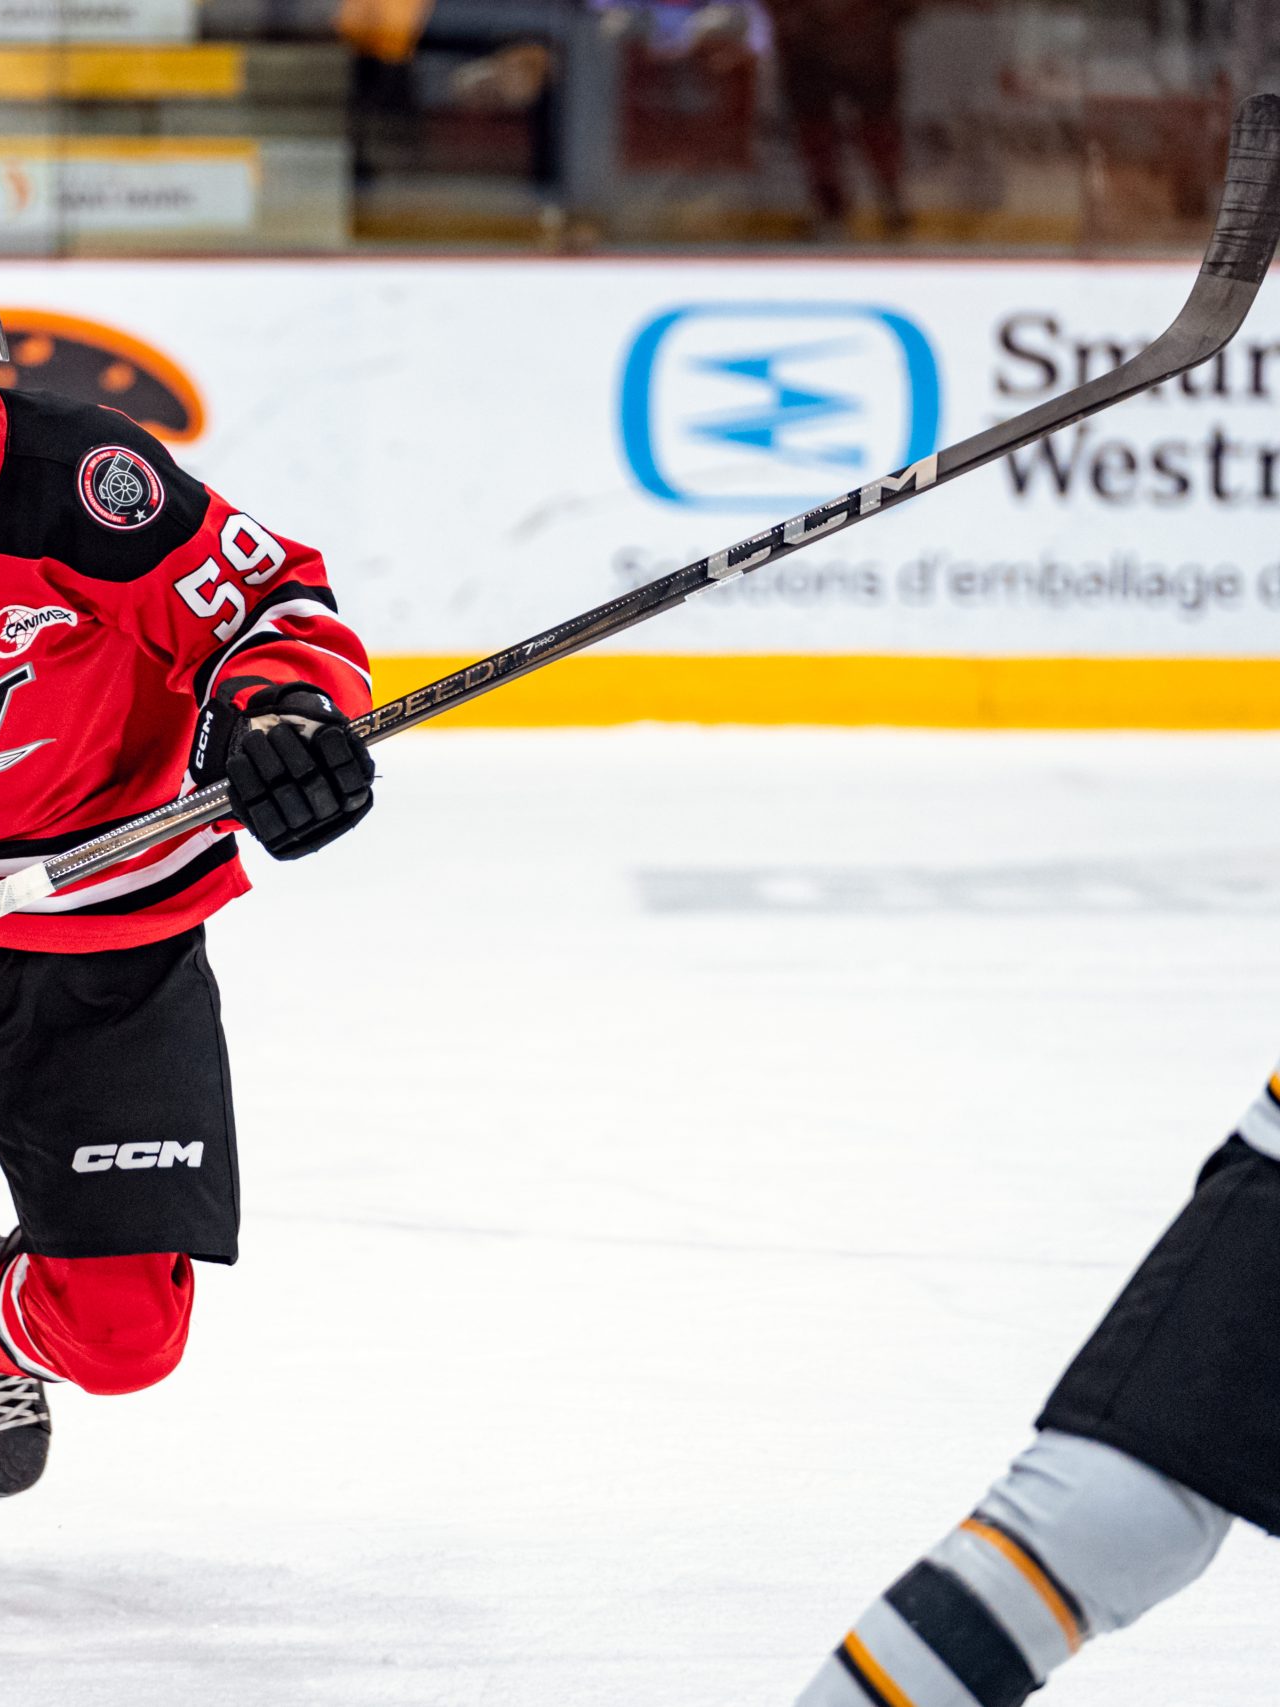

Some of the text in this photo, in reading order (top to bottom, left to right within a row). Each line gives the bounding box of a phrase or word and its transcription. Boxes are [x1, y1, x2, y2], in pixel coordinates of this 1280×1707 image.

[707, 453, 938, 580] CCM
[174, 512, 287, 642] 59
[195, 710, 215, 770] CCM
[71, 1140, 205, 1173] CCM
